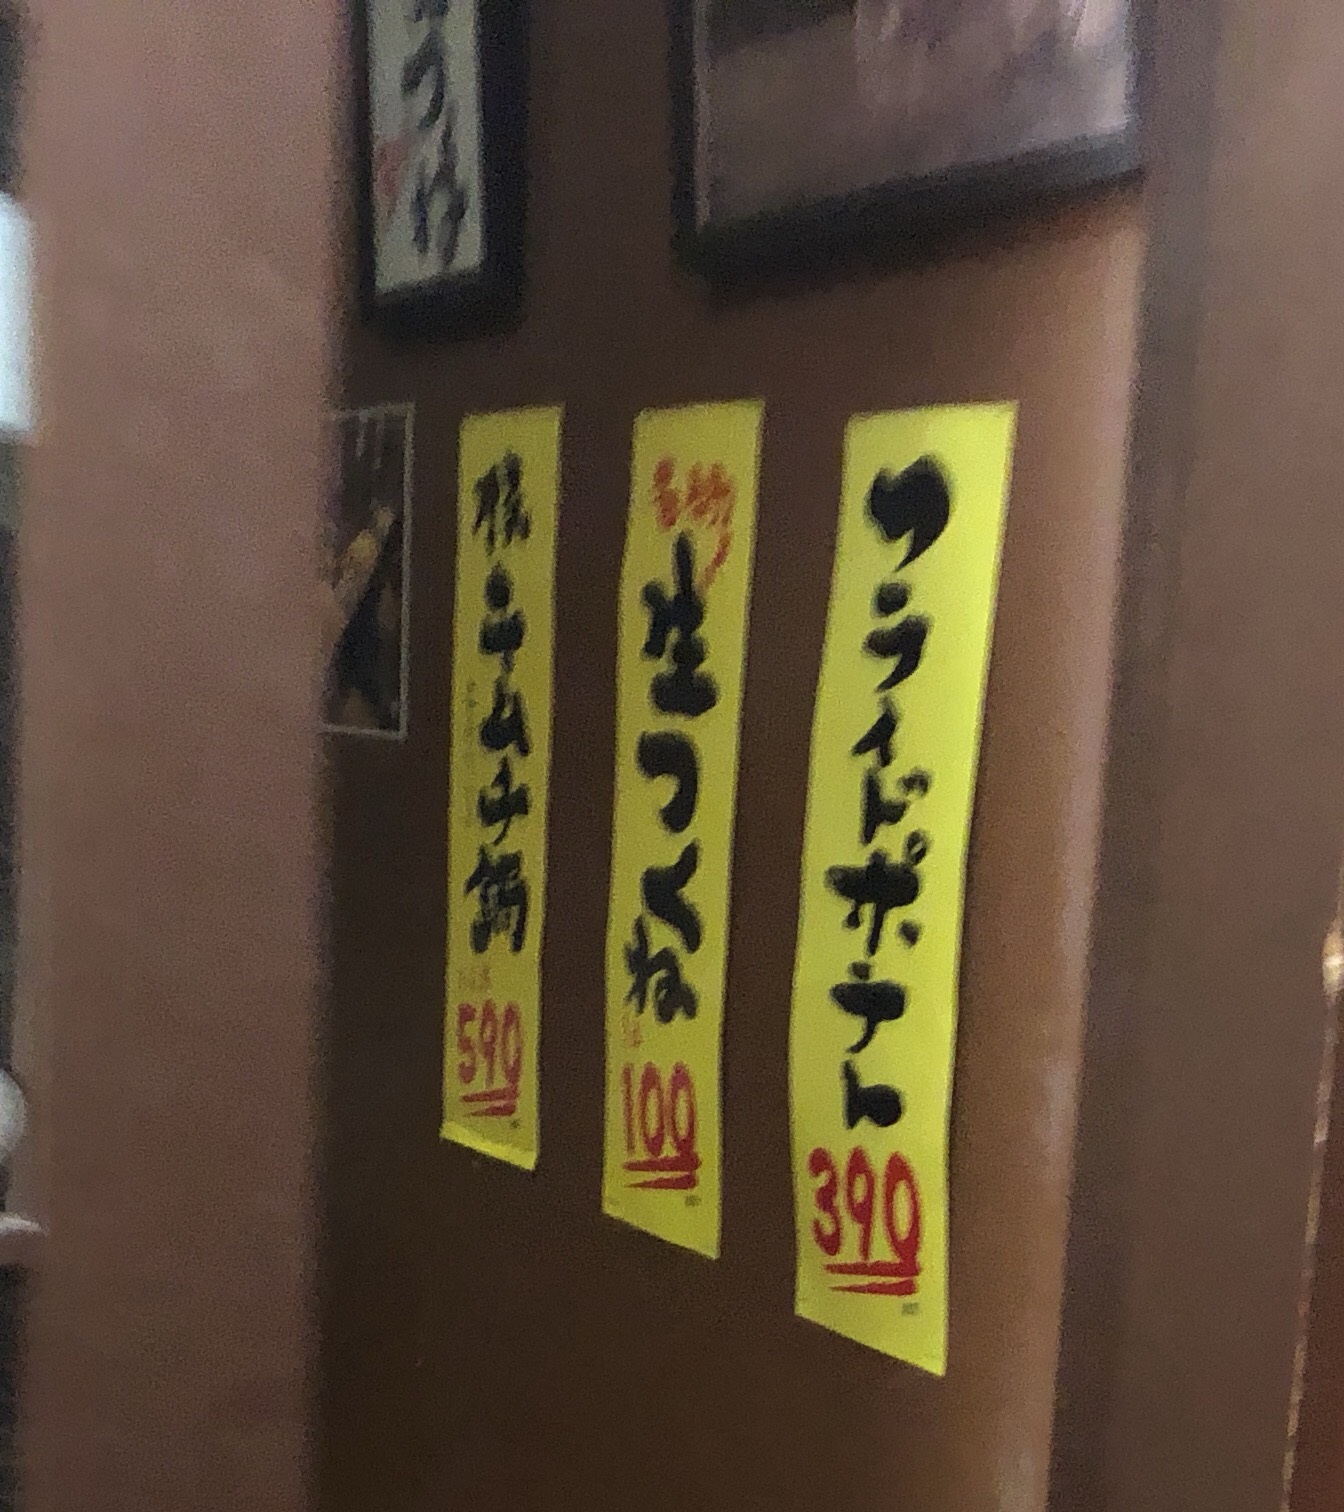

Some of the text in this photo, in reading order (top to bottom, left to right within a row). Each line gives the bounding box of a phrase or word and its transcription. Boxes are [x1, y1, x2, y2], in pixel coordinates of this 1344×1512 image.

[623, 530, 719, 1025] 生つくね
[825, 454, 951, 1130] フライドポテト
[456, 1000, 524, 1094] 590
[622, 1060, 699, 1156] 100
[807, 1146, 922, 1262] 390
